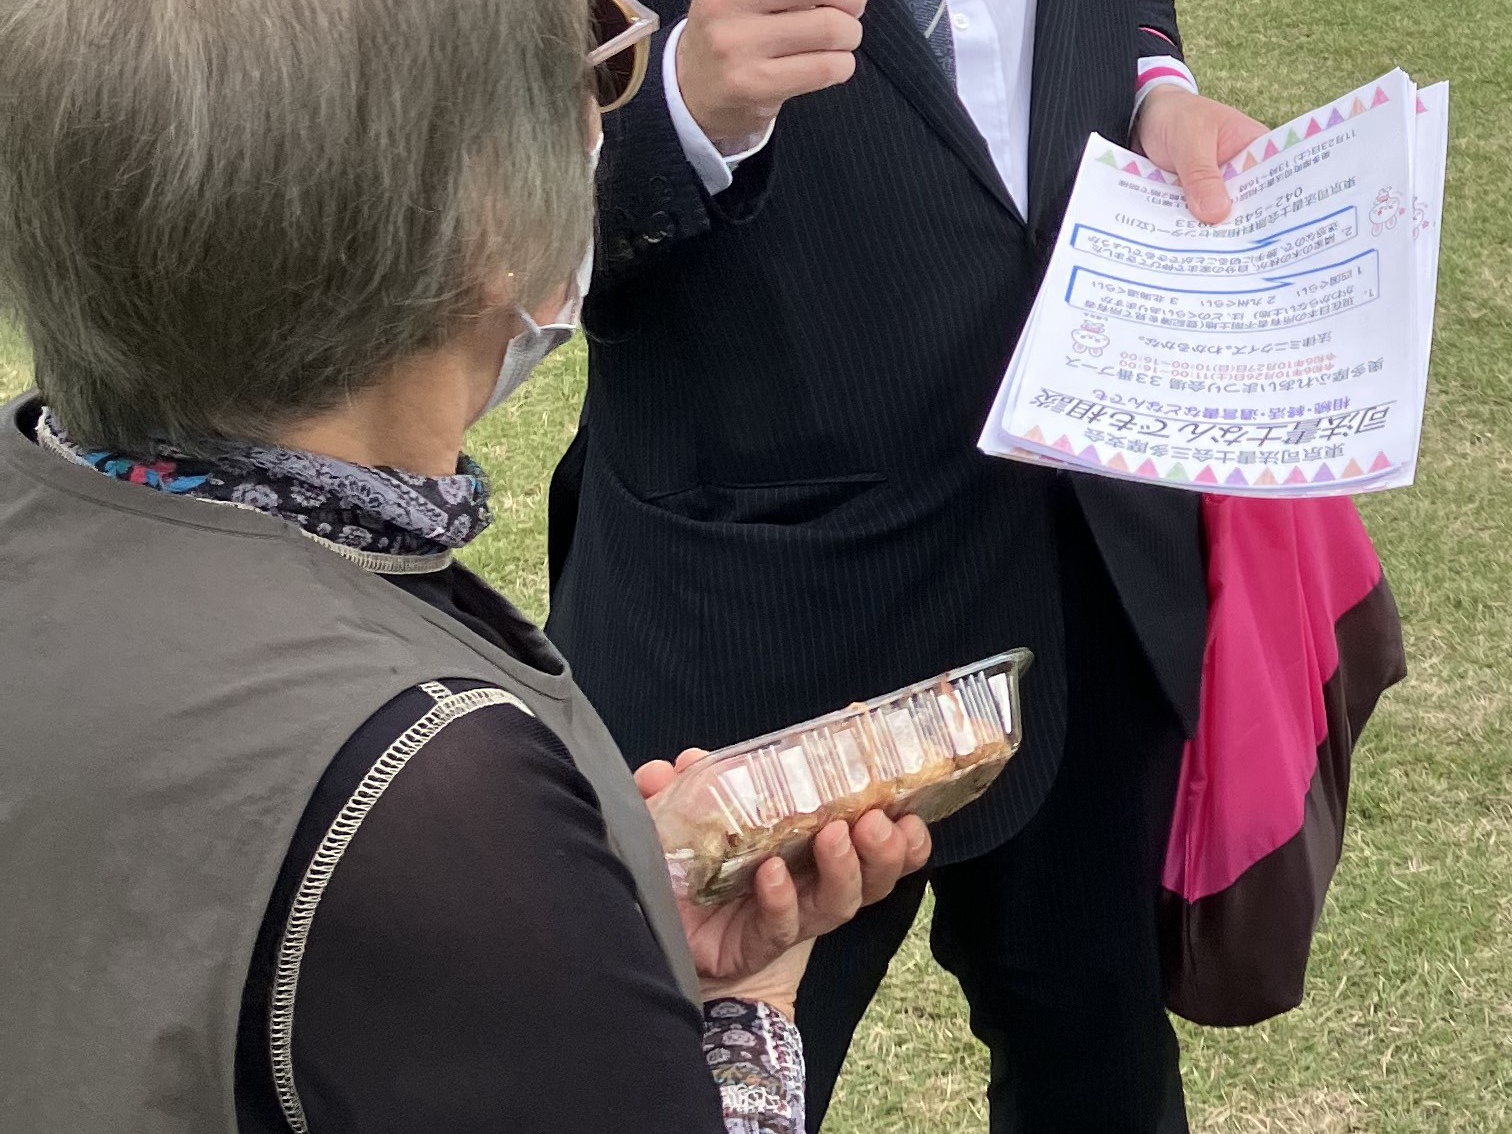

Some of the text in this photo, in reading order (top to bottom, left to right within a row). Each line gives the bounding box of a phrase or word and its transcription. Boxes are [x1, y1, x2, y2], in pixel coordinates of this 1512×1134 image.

[1029, 388, 1390, 448] 司法書士なんでも相談
[1084, 427, 1345, 465] 東京司法書士会三多摩支会
